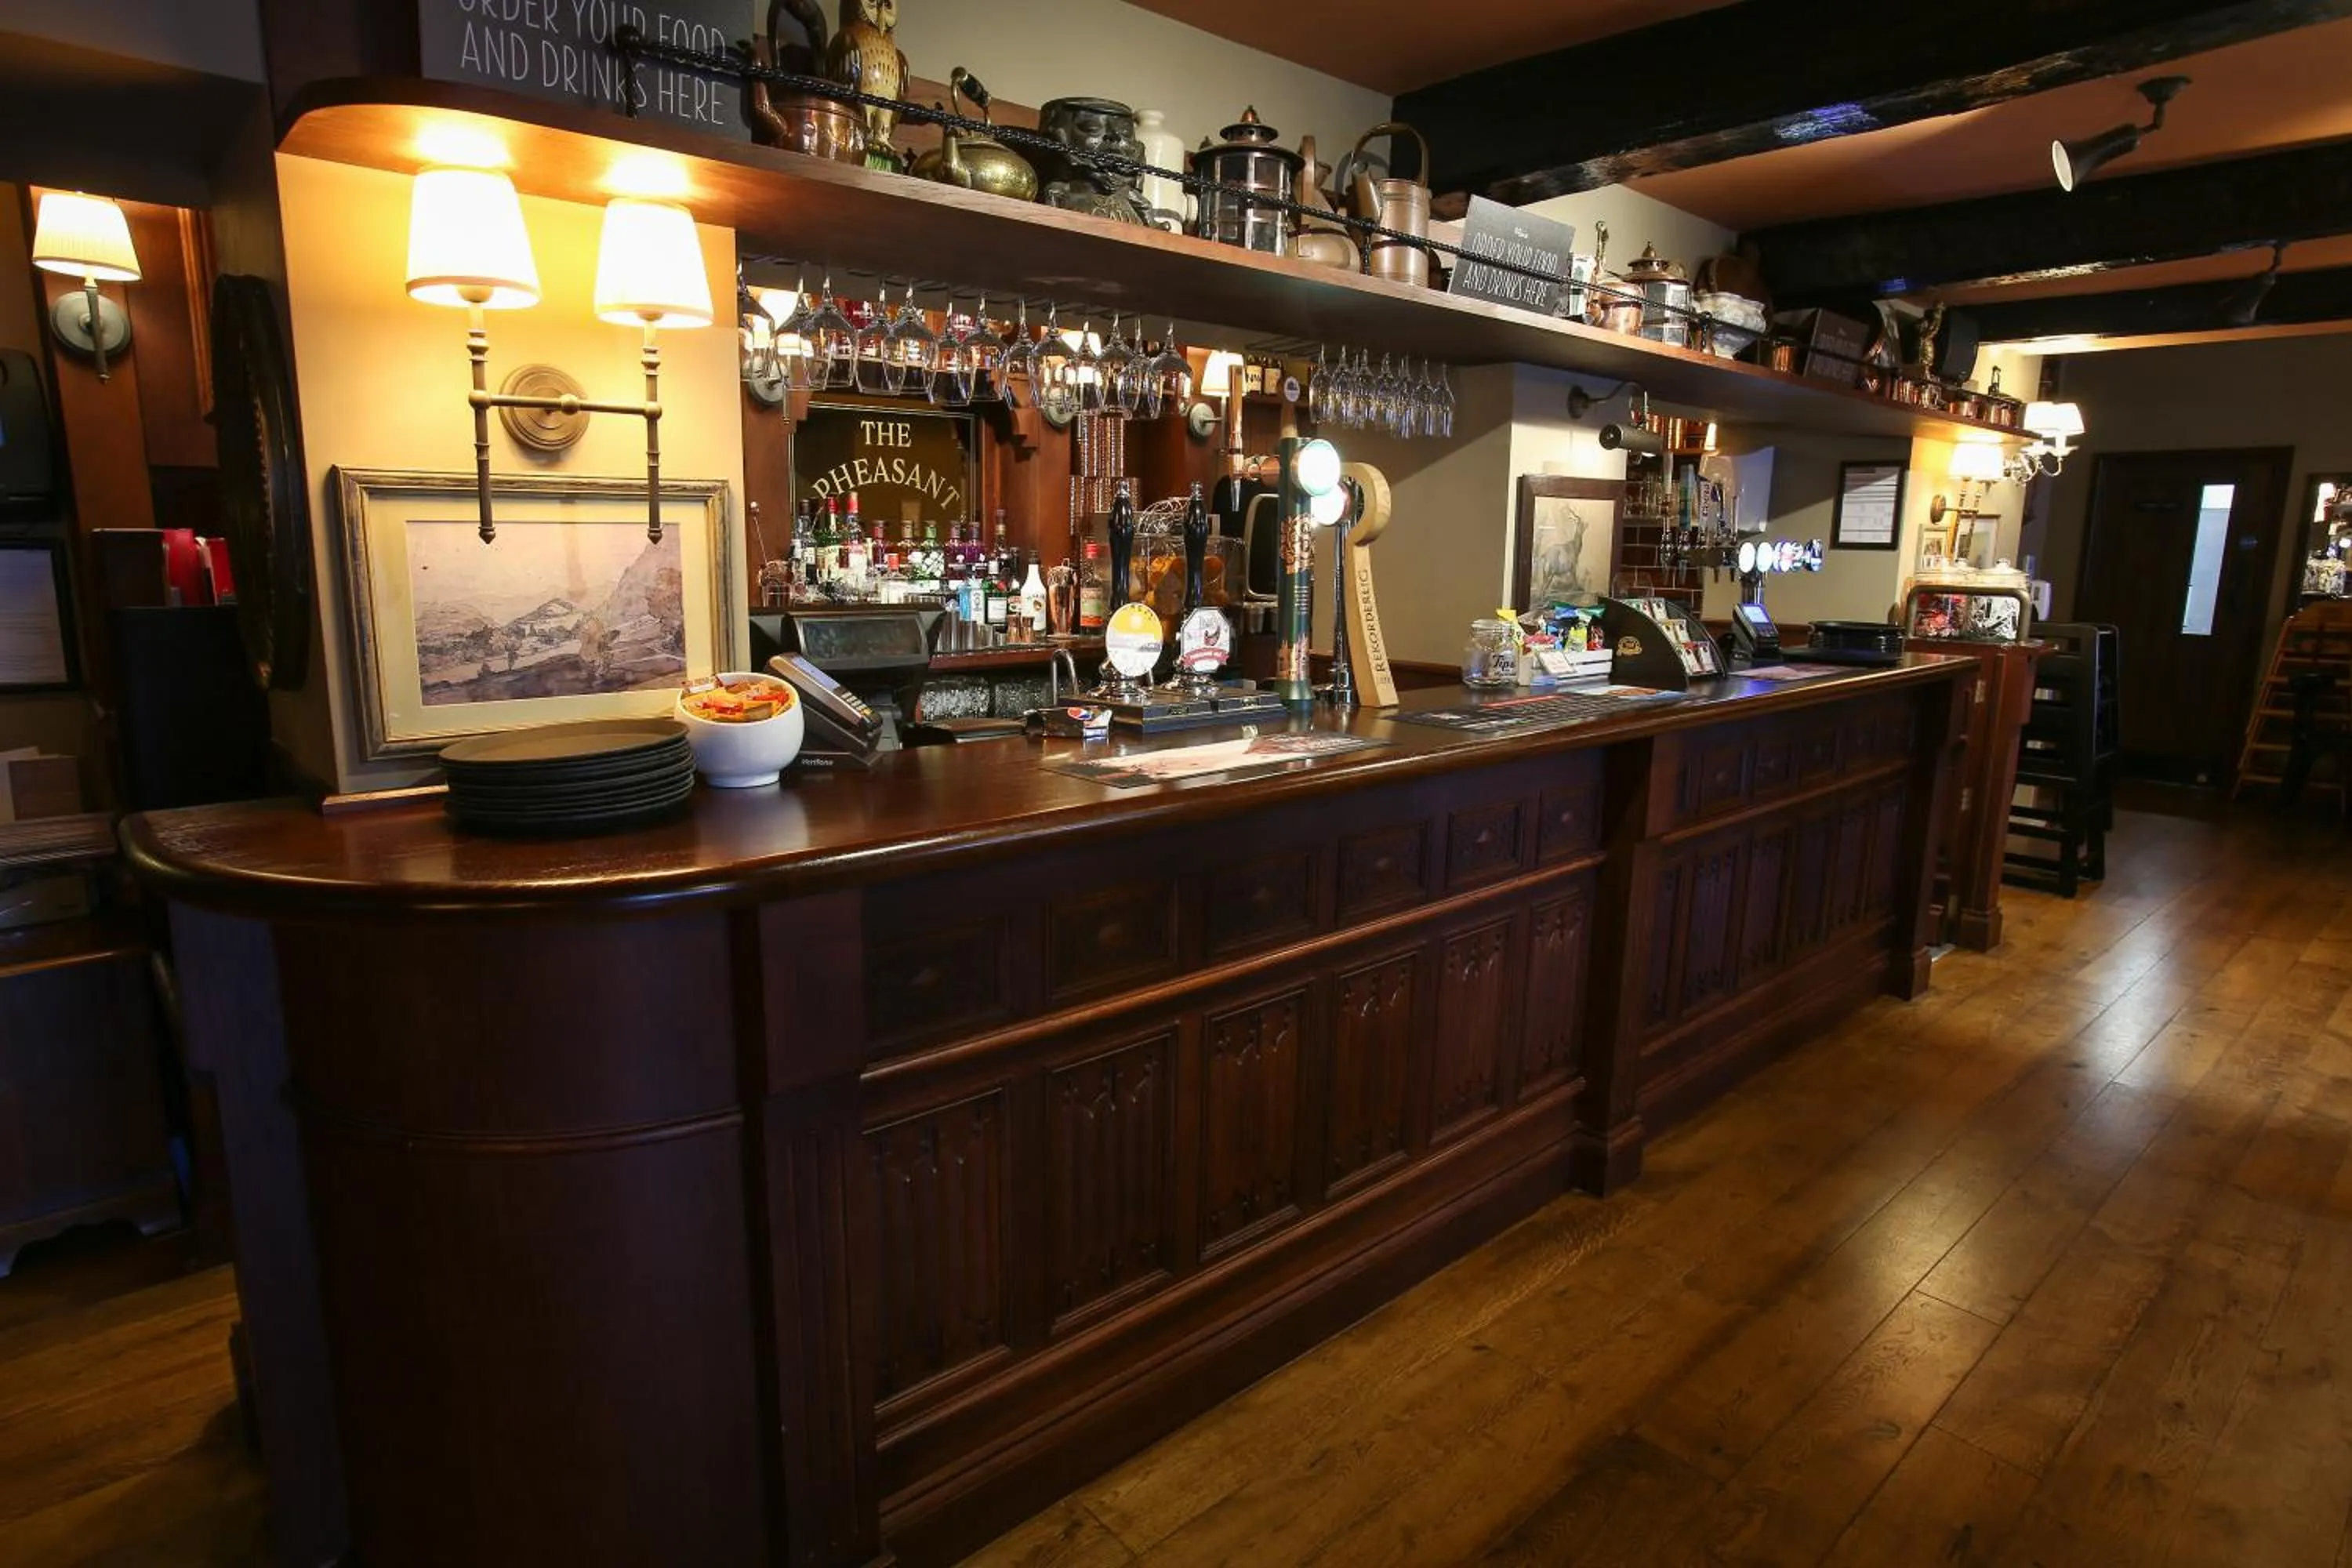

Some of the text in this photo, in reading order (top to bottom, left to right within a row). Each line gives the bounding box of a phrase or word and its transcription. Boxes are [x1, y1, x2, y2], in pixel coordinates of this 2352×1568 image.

[459, 0, 559, 34] DER
[459, 21, 724, 125] AND DRINKS HERE
[860, 420, 912, 448] THE
[811, 456, 960, 510] PHEASANT
[1355, 568, 1385, 673] REKORDERLIG
